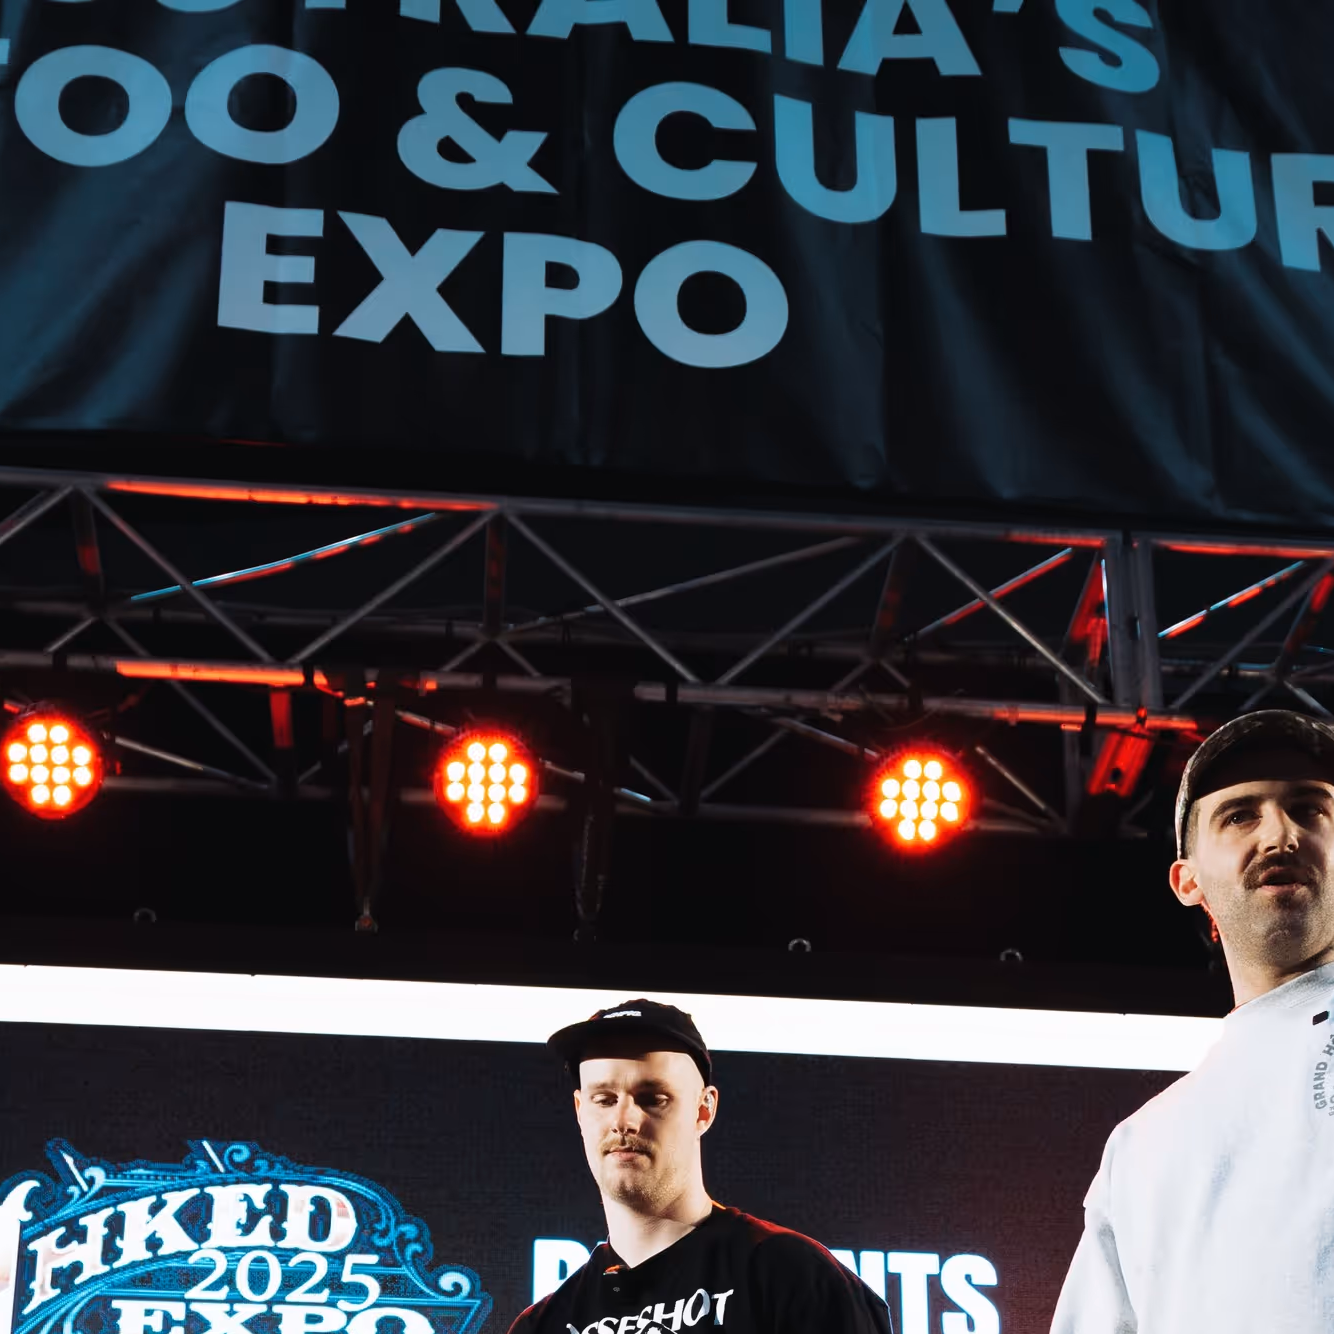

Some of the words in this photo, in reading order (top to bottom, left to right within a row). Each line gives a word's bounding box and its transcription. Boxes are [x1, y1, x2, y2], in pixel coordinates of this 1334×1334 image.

[397, 66, 558, 194] &
[217, 201, 789, 368] EXPO
[1313, 1061, 1328, 1110] GRAND
[185, 1250, 381, 1311] 2025
